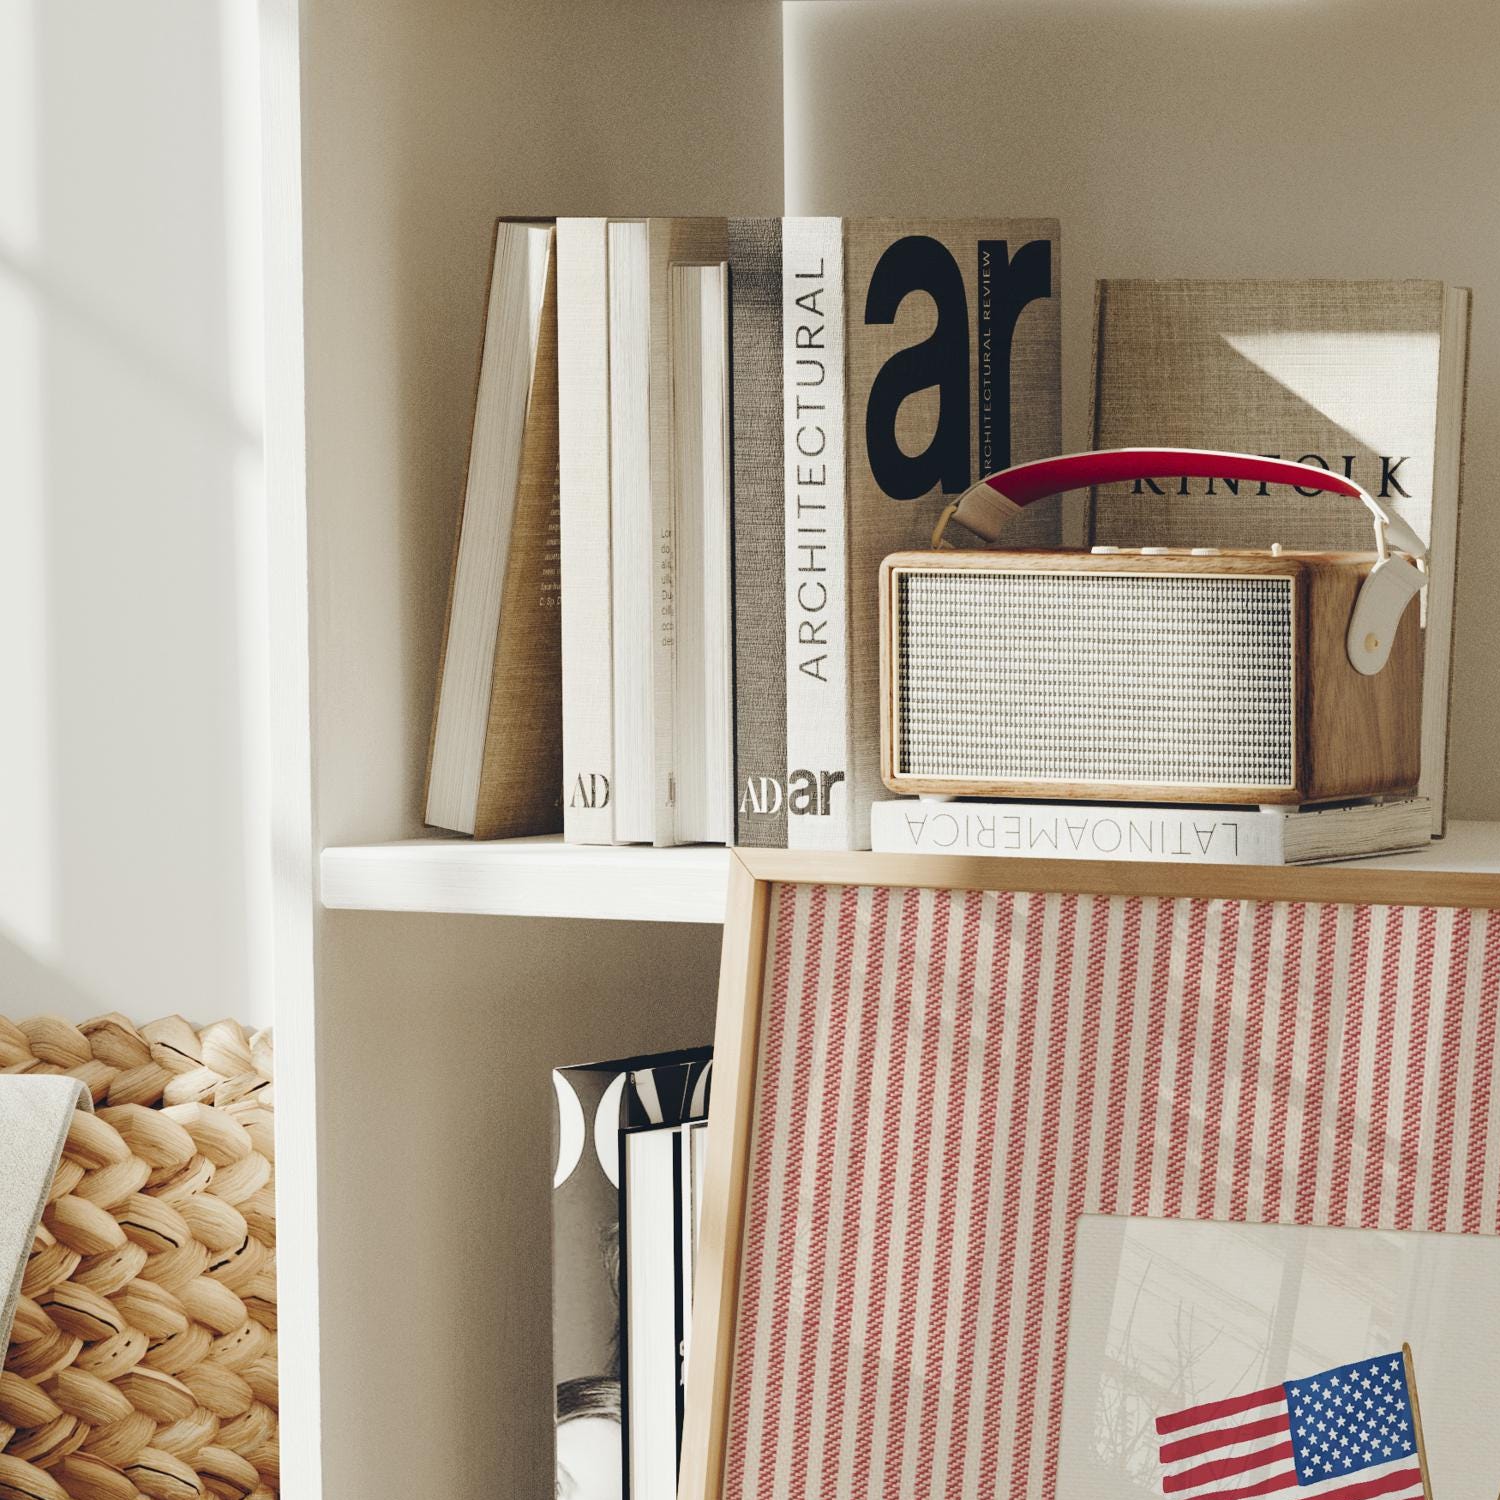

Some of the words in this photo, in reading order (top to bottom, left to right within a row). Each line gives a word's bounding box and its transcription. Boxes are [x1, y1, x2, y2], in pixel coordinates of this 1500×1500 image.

[983, 250, 991, 320] REVIEW
[864, 235, 1052, 501] ar
[795, 257, 828, 682] ARCHITECTURAL
[569, 772, 610, 809] AD
[739, 776, 783, 814] AD
[788, 768, 845, 816] ar
[904, 812, 1239, 857] LATINOAMERICA
